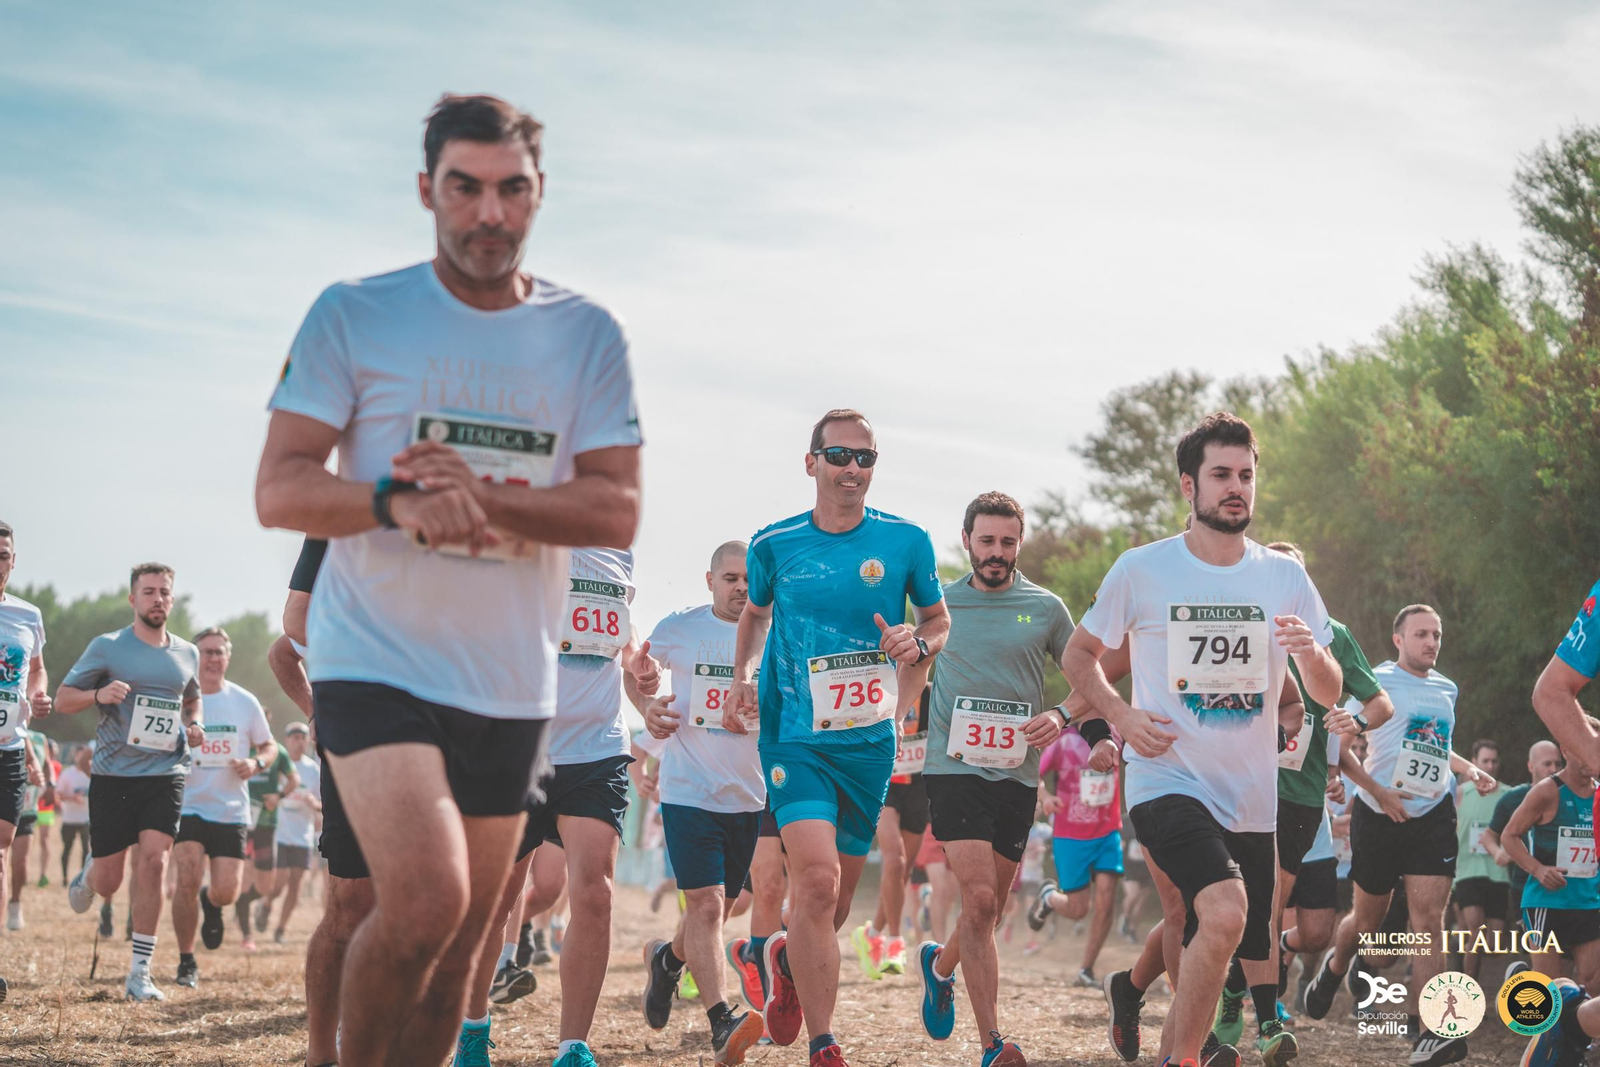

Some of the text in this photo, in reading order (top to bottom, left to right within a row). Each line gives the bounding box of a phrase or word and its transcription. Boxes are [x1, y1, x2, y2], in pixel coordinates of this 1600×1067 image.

[579, 581, 614, 594] ITÁLICA
[572, 606, 619, 636] 618
[1197, 607, 1243, 619] ITÁLICA
[1188, 636, 1251, 664] 794
[833, 655, 873, 667] ITÁLICA
[714, 667, 734, 676] ITÁL
[829, 679, 883, 710] 736
[976, 701, 1011, 713] ITÁLICA
[144, 715, 174, 734] 752
[966, 724, 1015, 749] 313
[201, 740, 231, 755] 665
[1406, 759, 1440, 782] 373
